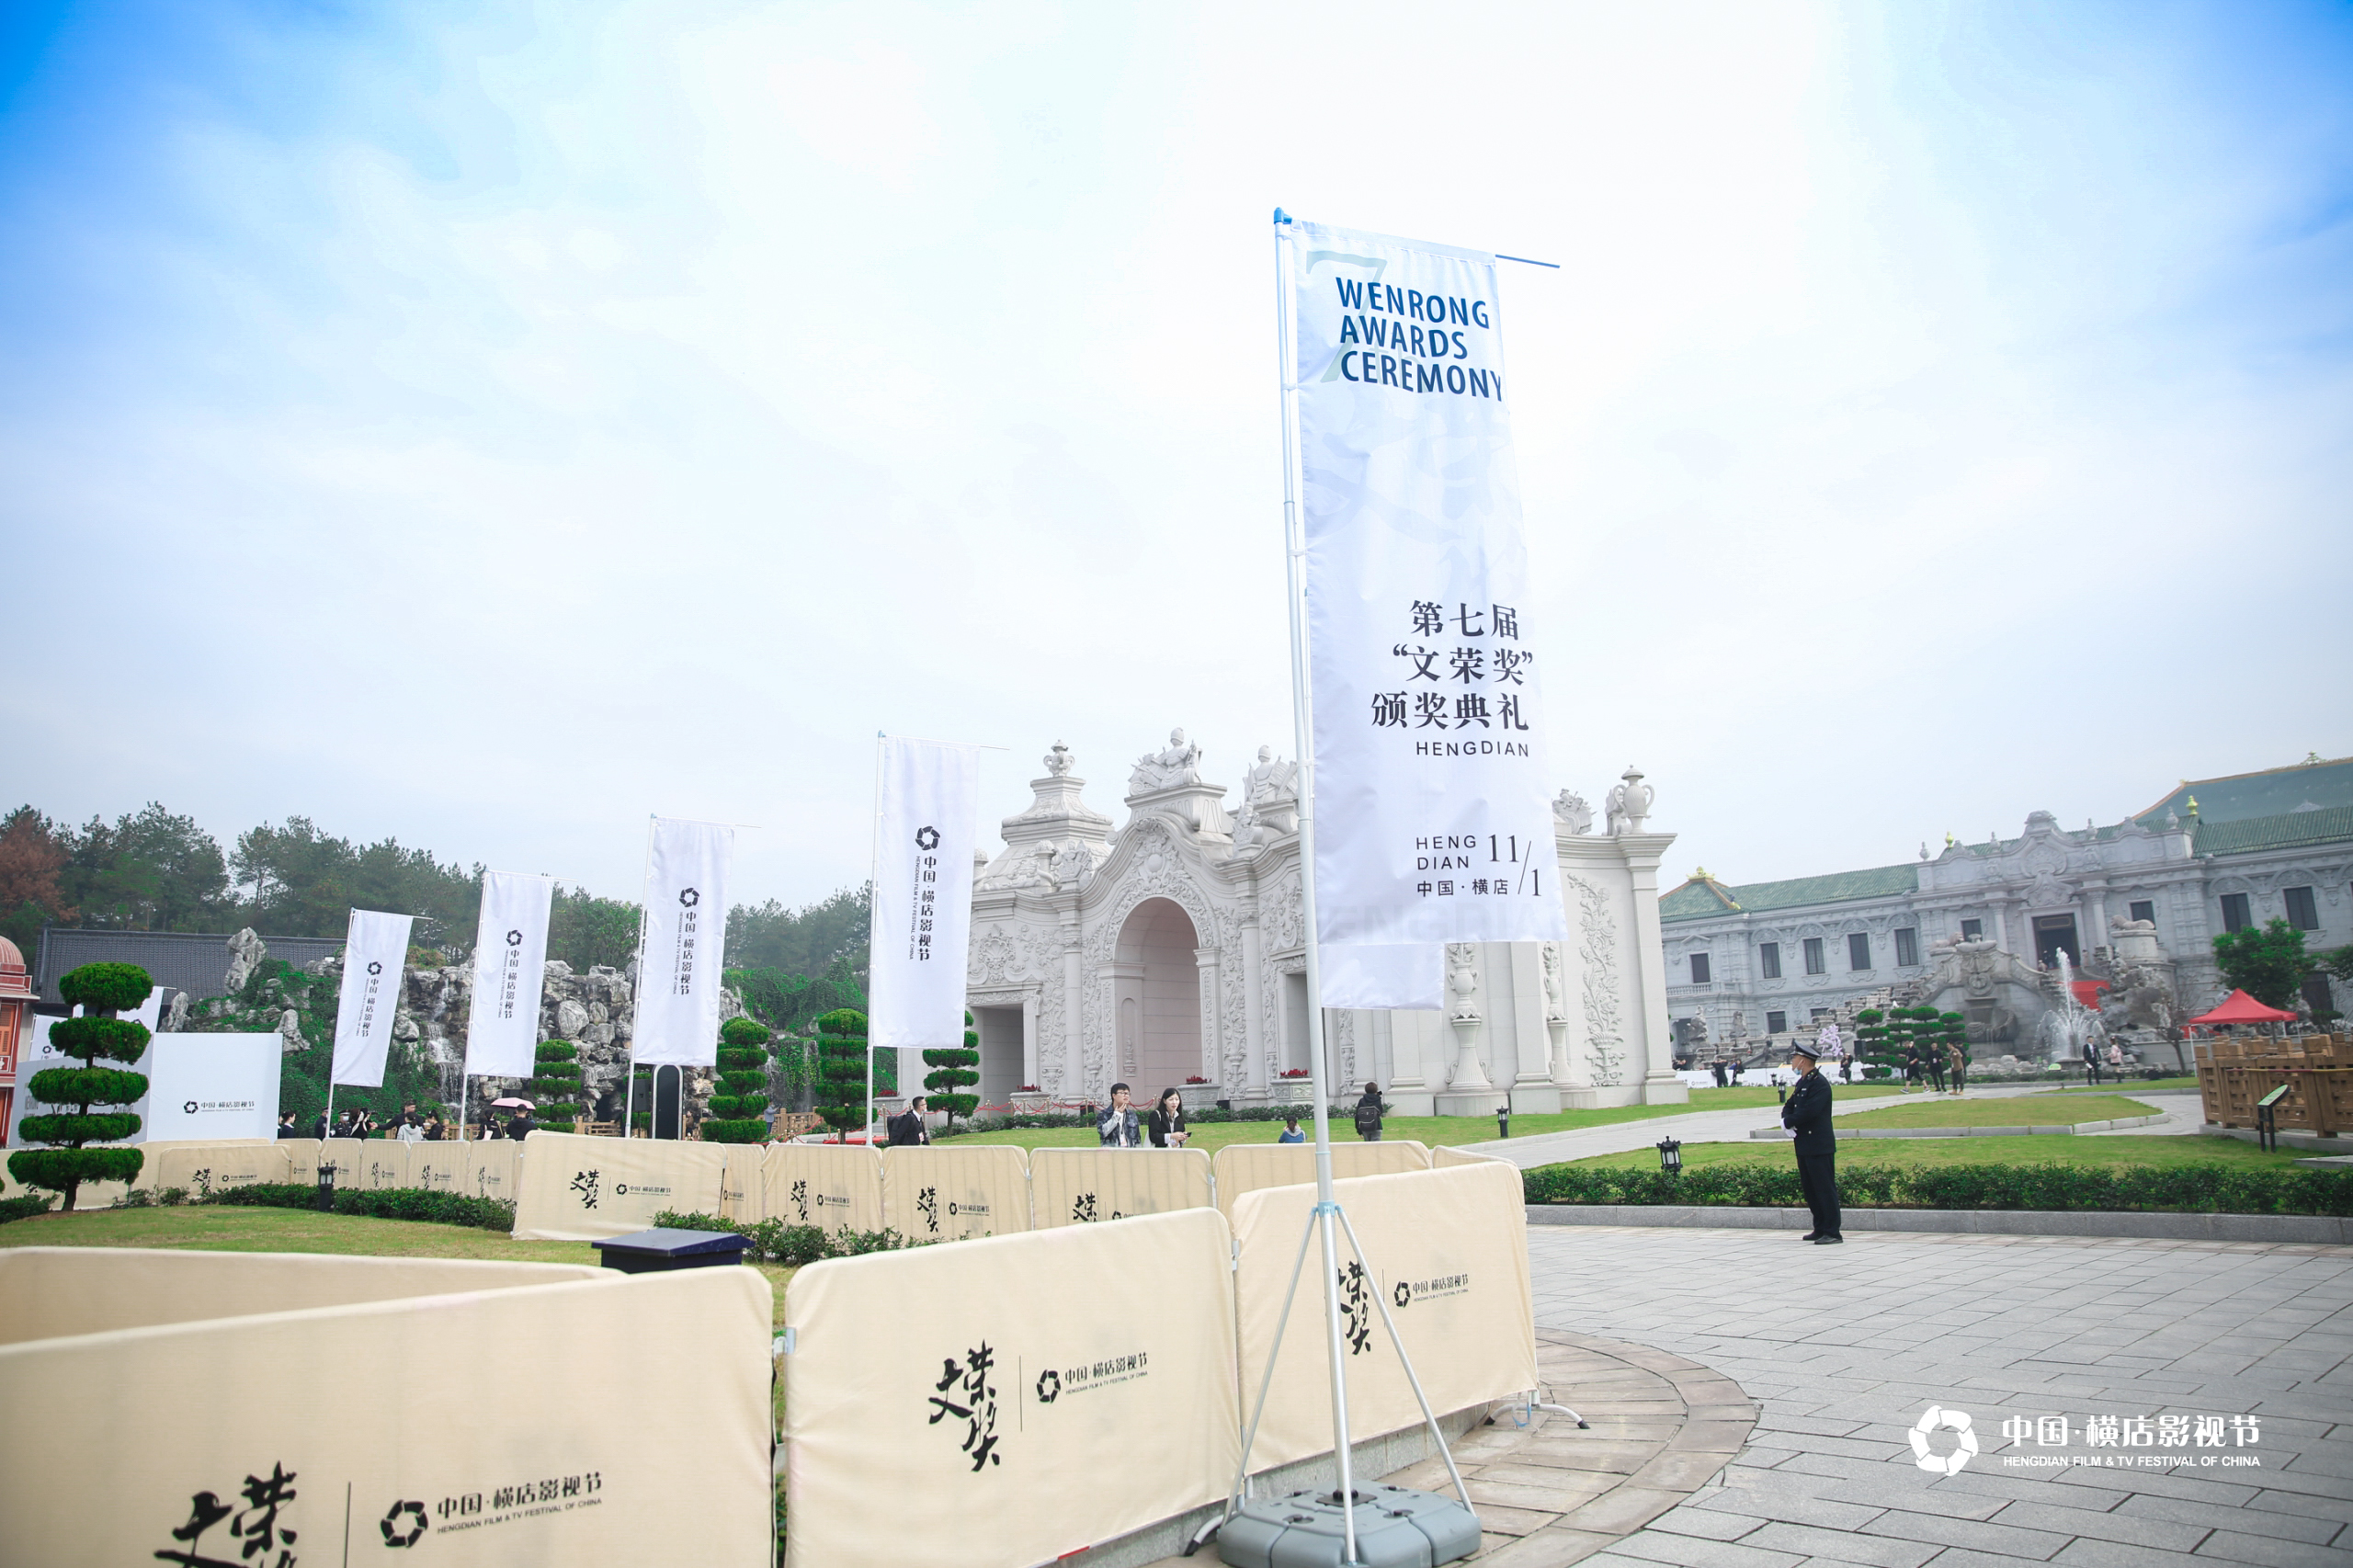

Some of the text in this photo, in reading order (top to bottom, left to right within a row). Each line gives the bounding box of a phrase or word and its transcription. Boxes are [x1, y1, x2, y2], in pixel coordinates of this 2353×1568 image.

[1336, 277, 1490, 329] WENRONG
[1340, 315, 1468, 359] AWARDS
[1341, 350, 1502, 403] CEREMONY
[1409, 600, 1518, 640] 第七届
[1370, 690, 1529, 731] 颁奖典礼
[1416, 741, 1529, 757] HENGDIAN
[1416, 835, 1476, 849] HENG
[1417, 856, 1469, 870] DIAN
[1417, 879, 1508, 897] 中国·横店
[918, 856, 937, 961] 中国·横店影视节
[1065, 1352, 1147, 1384] 中国·横店影视节
[153, 1460, 297, 1568] 文荣
[438, 1471, 603, 1518] 中国·横店影视节
[438, 1519, 482, 1534] HENGDIAN
[484, 1515, 503, 1526] FILM
[512, 1510, 523, 1519] TV
[525, 1505, 563, 1517] FESTIVAL
[565, 1501, 575, 1510] OF
[578, 1497, 602, 1507] CHINA
